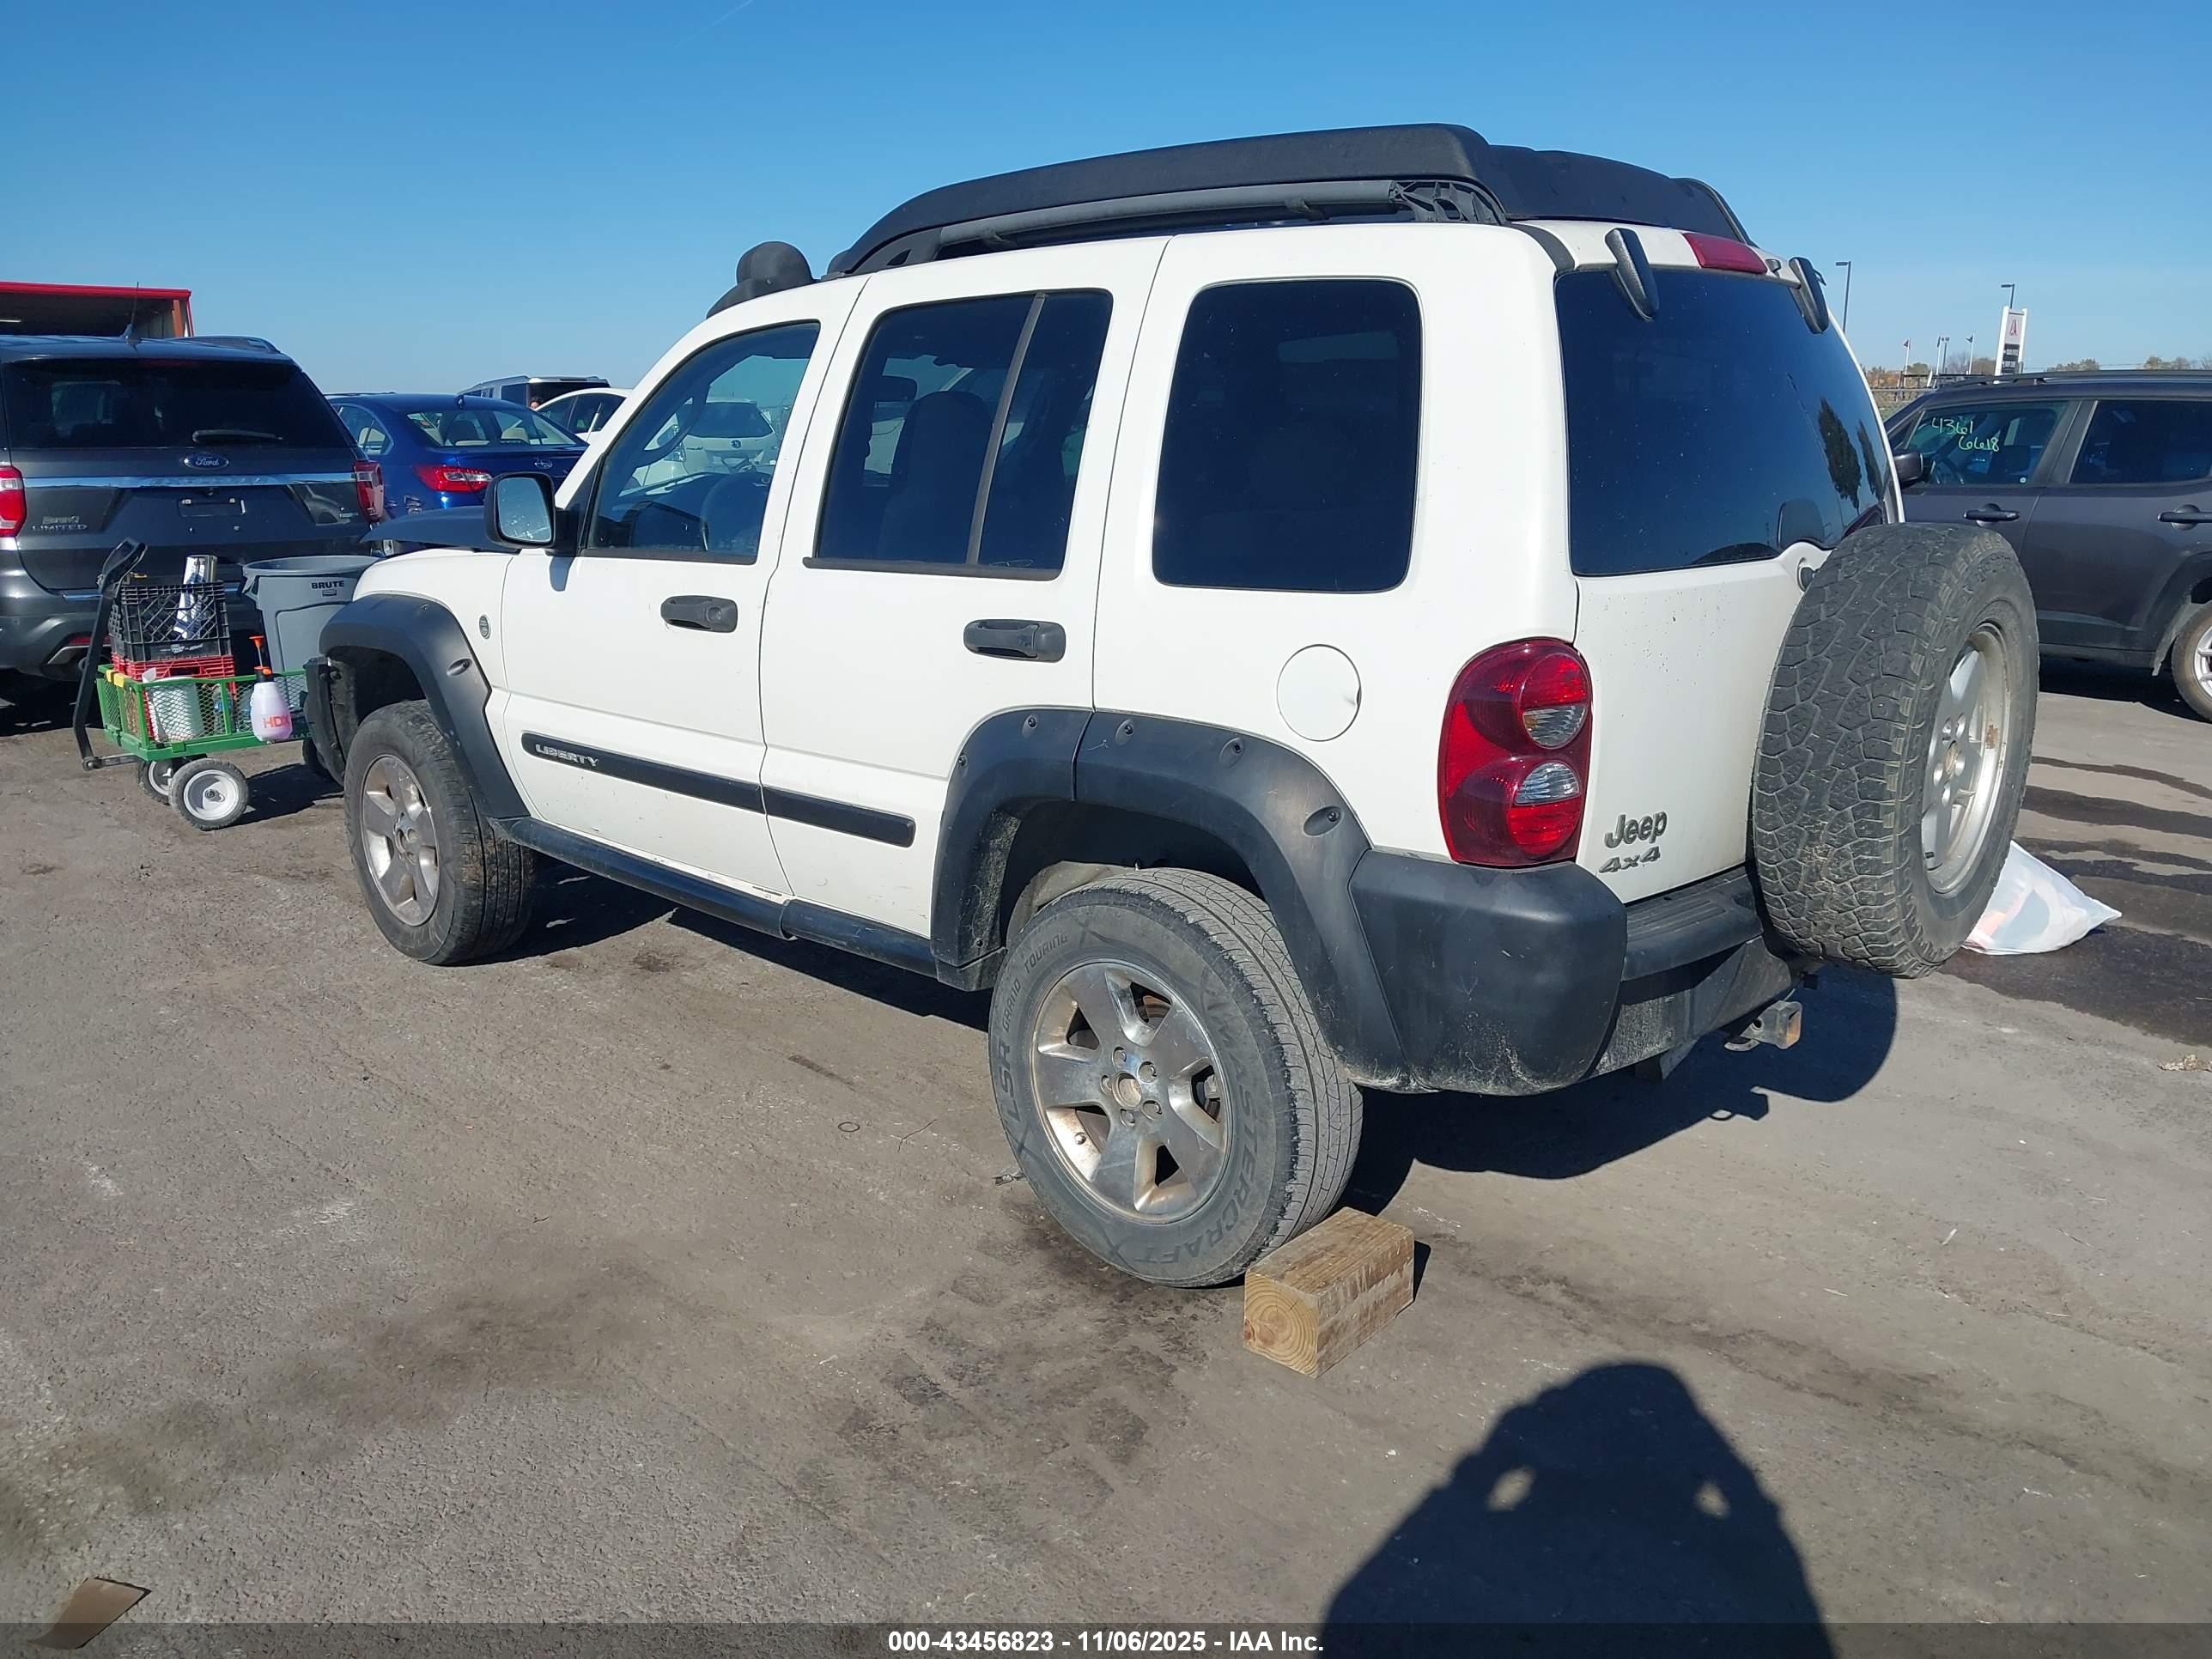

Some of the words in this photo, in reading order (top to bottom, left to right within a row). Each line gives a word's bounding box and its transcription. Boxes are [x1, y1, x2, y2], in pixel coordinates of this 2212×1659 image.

[1931, 416, 1974, 435] 4361
[1958, 435, 2001, 453] 6618
[311, 580, 344, 590] BRUTE
[262, 714, 290, 729] HDX
[535, 744, 599, 767] LIBERTY
[1604, 811, 1668, 849] Jeep
[1598, 846, 1661, 873] 4x4
[1023, 933, 1069, 975] TOURING
[1001, 976, 1022, 1032] GRAND
[996, 1036, 1021, 1122] LSR
